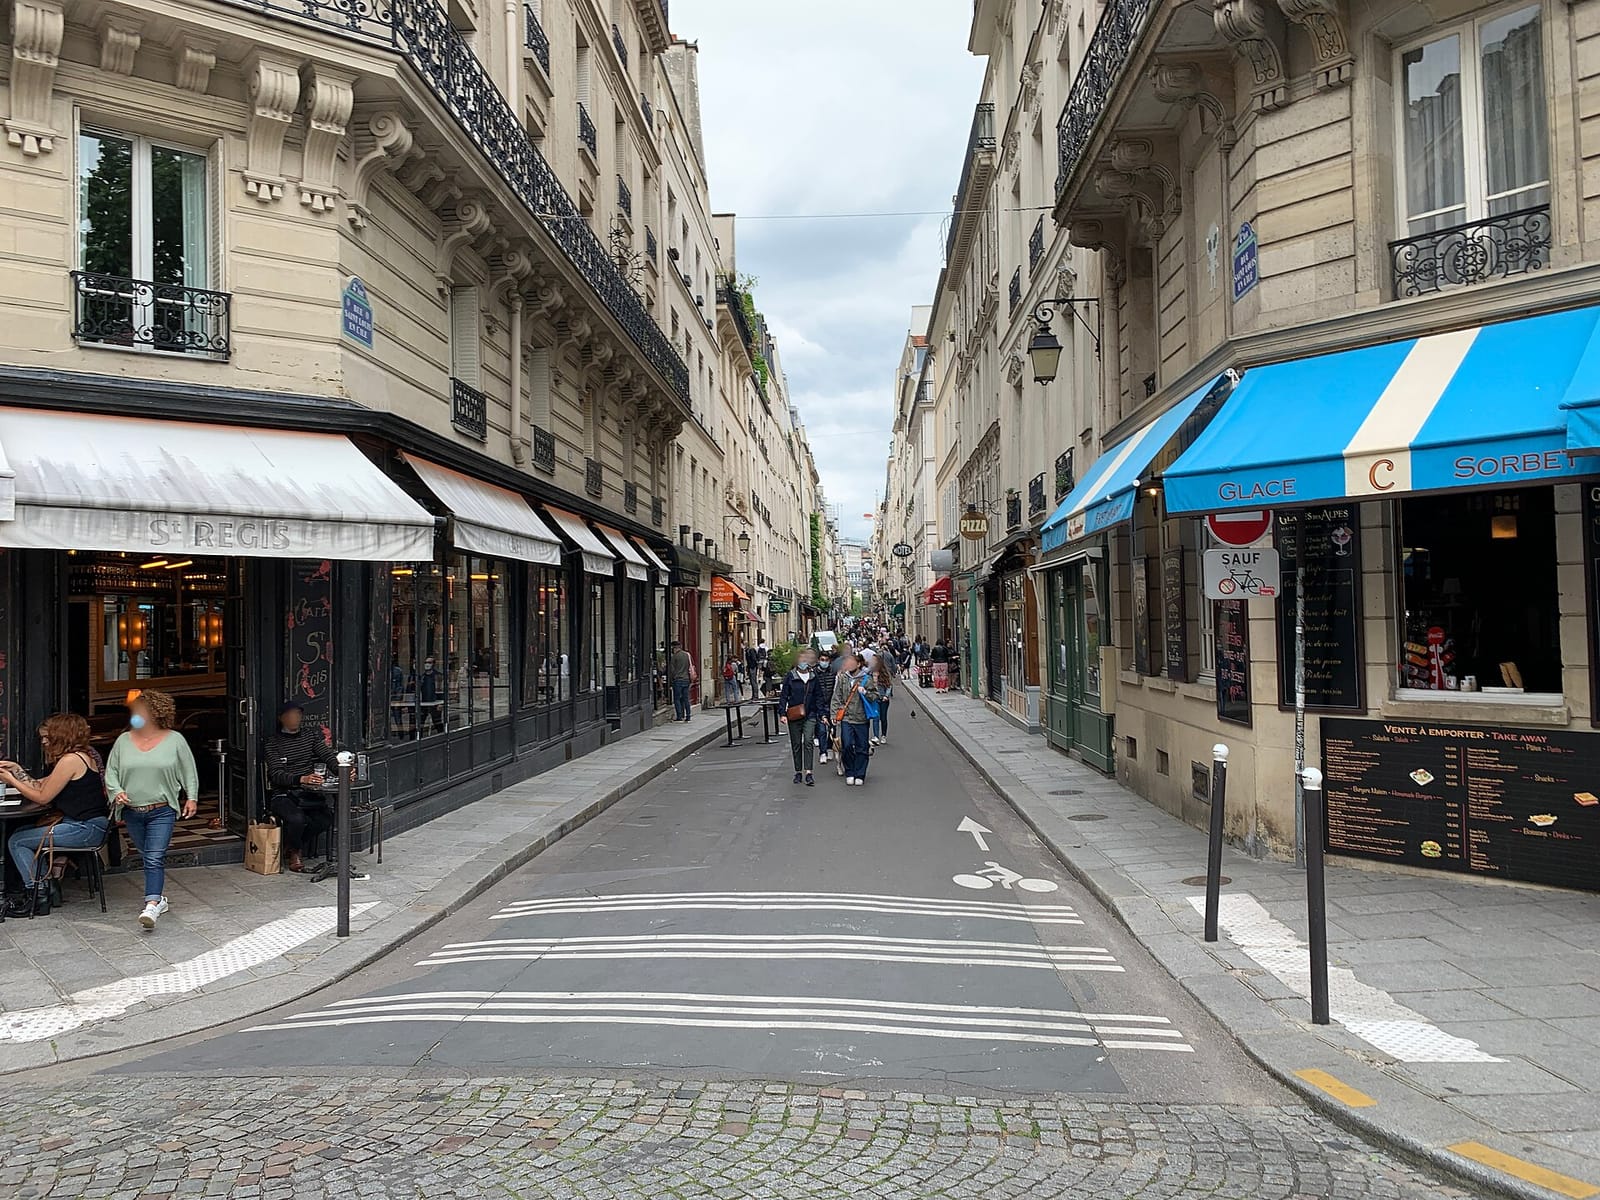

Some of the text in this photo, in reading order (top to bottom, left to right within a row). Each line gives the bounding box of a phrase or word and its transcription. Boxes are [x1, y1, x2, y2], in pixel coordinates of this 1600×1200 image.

[1368, 458, 1395, 491] C
[1218, 478, 1297, 502] GLACE
[1321, 509, 1349, 522] ALPES
[149, 519, 290, 550] St REGIS
[960, 519, 987, 532] PIZZA
[1221, 552, 1261, 565] SAUF
[1383, 724, 1548, 743] VENTE À EMPORTER TAKE AWAY
